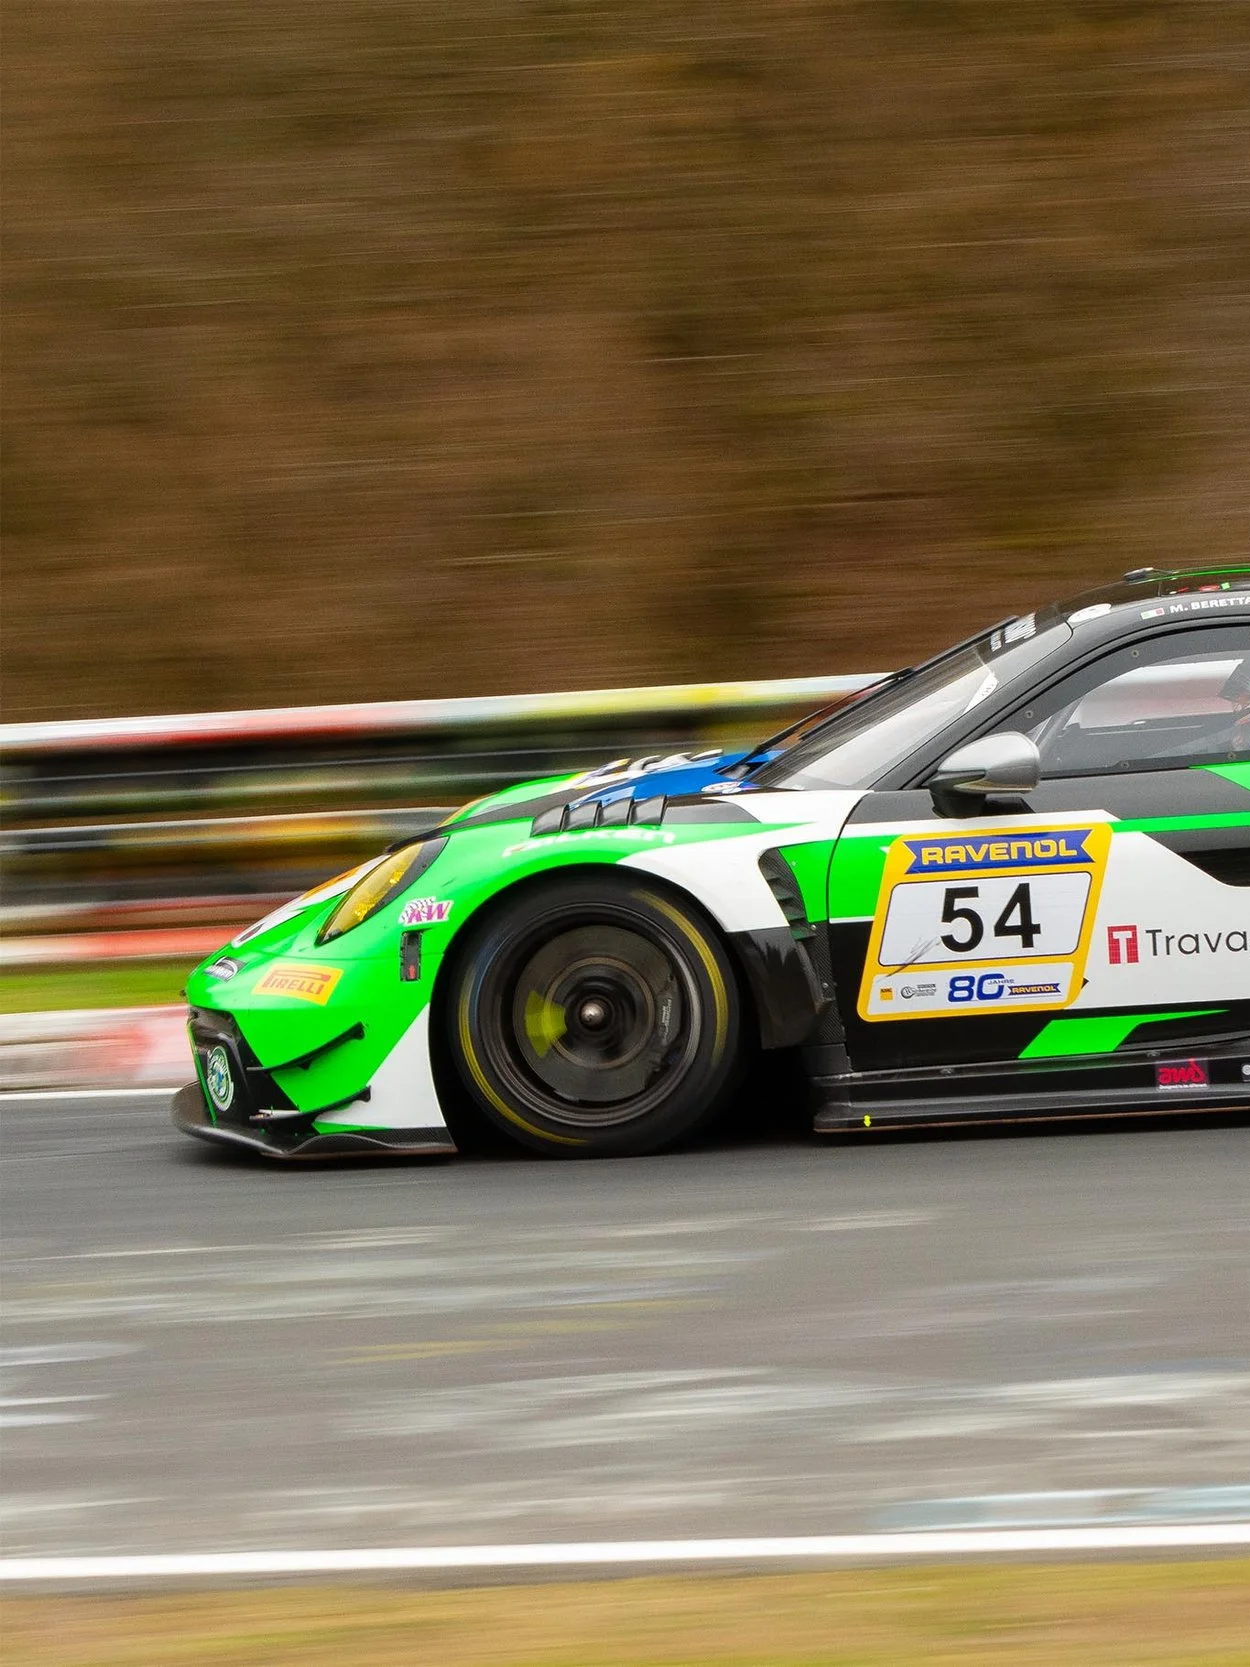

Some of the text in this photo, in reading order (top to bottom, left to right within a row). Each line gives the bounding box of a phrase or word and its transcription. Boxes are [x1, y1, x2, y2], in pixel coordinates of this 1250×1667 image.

[1169, 605, 1189, 614] M.
[921, 838, 1078, 866] RAVENOL
[939, 883, 1042, 953] 54
[262, 969, 331, 996] PIRELLI
[948, 973, 1005, 1003] 80
[1011, 984, 1057, 995] RAVENOL
